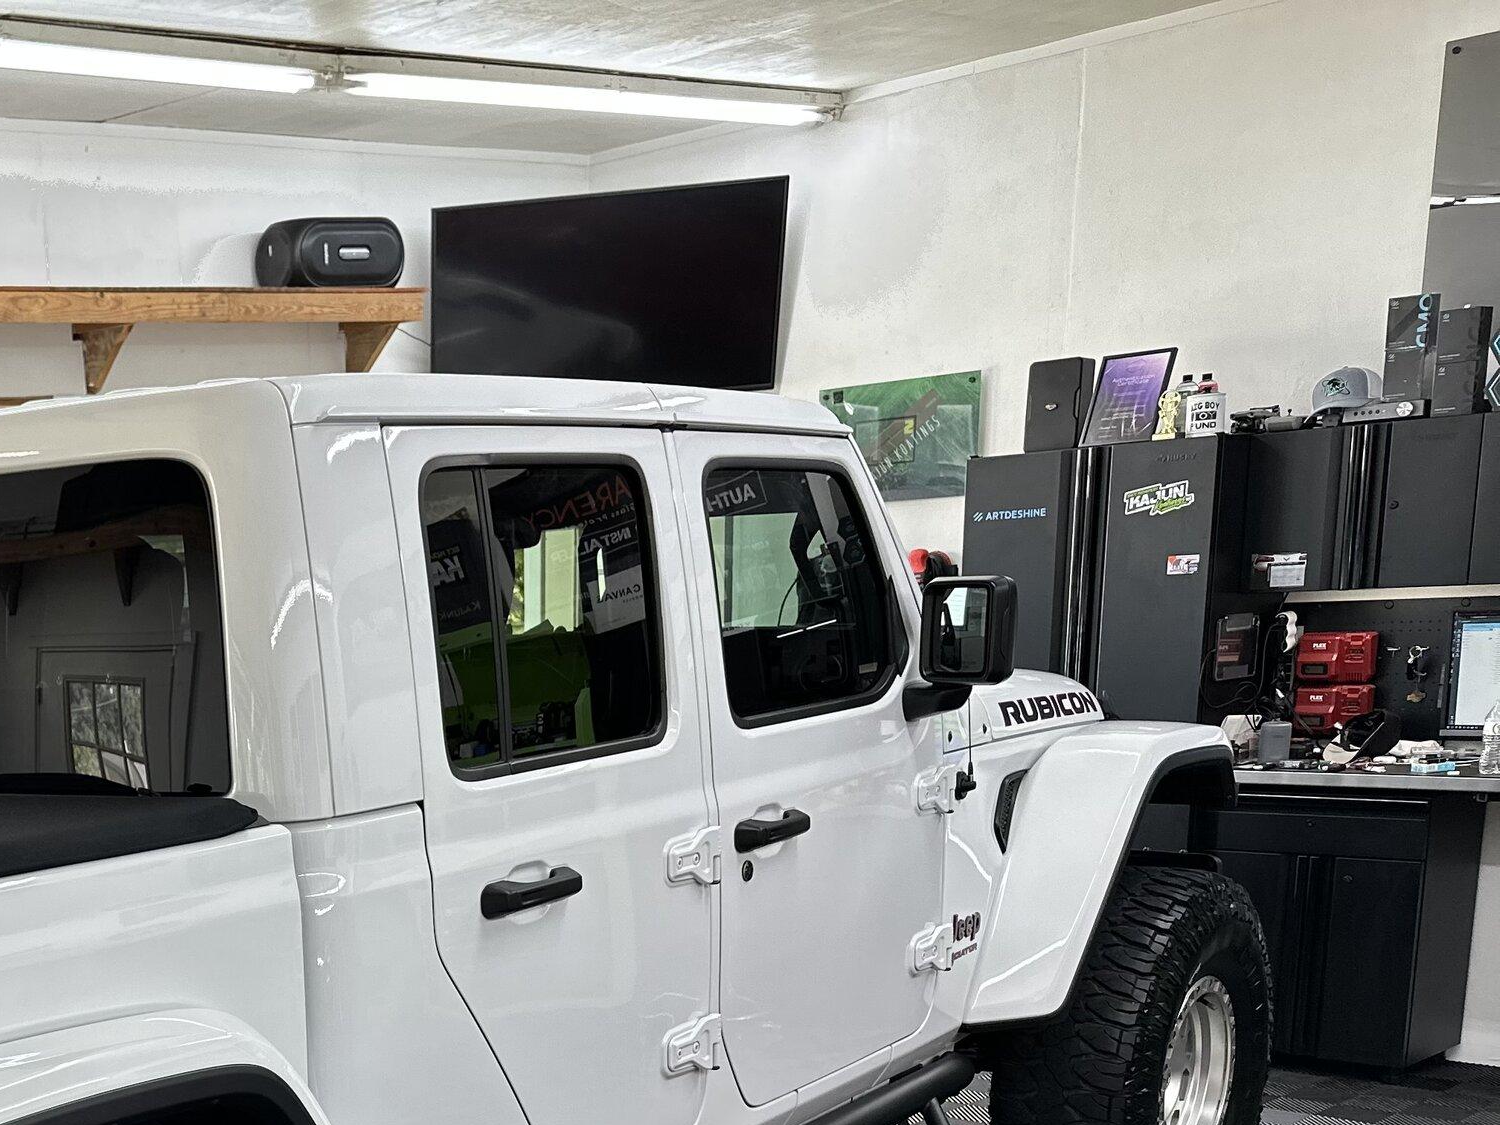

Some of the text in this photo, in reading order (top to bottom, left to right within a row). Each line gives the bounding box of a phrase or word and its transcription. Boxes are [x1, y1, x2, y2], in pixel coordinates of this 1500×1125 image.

[894, 414, 941, 459] KOATINGS
[985, 507, 1047, 521] ARTDESHINE
[1312, 642, 1327, 650] FLEX
[1309, 694, 1323, 702] FLEX
[998, 691, 1098, 727] RUBICON
